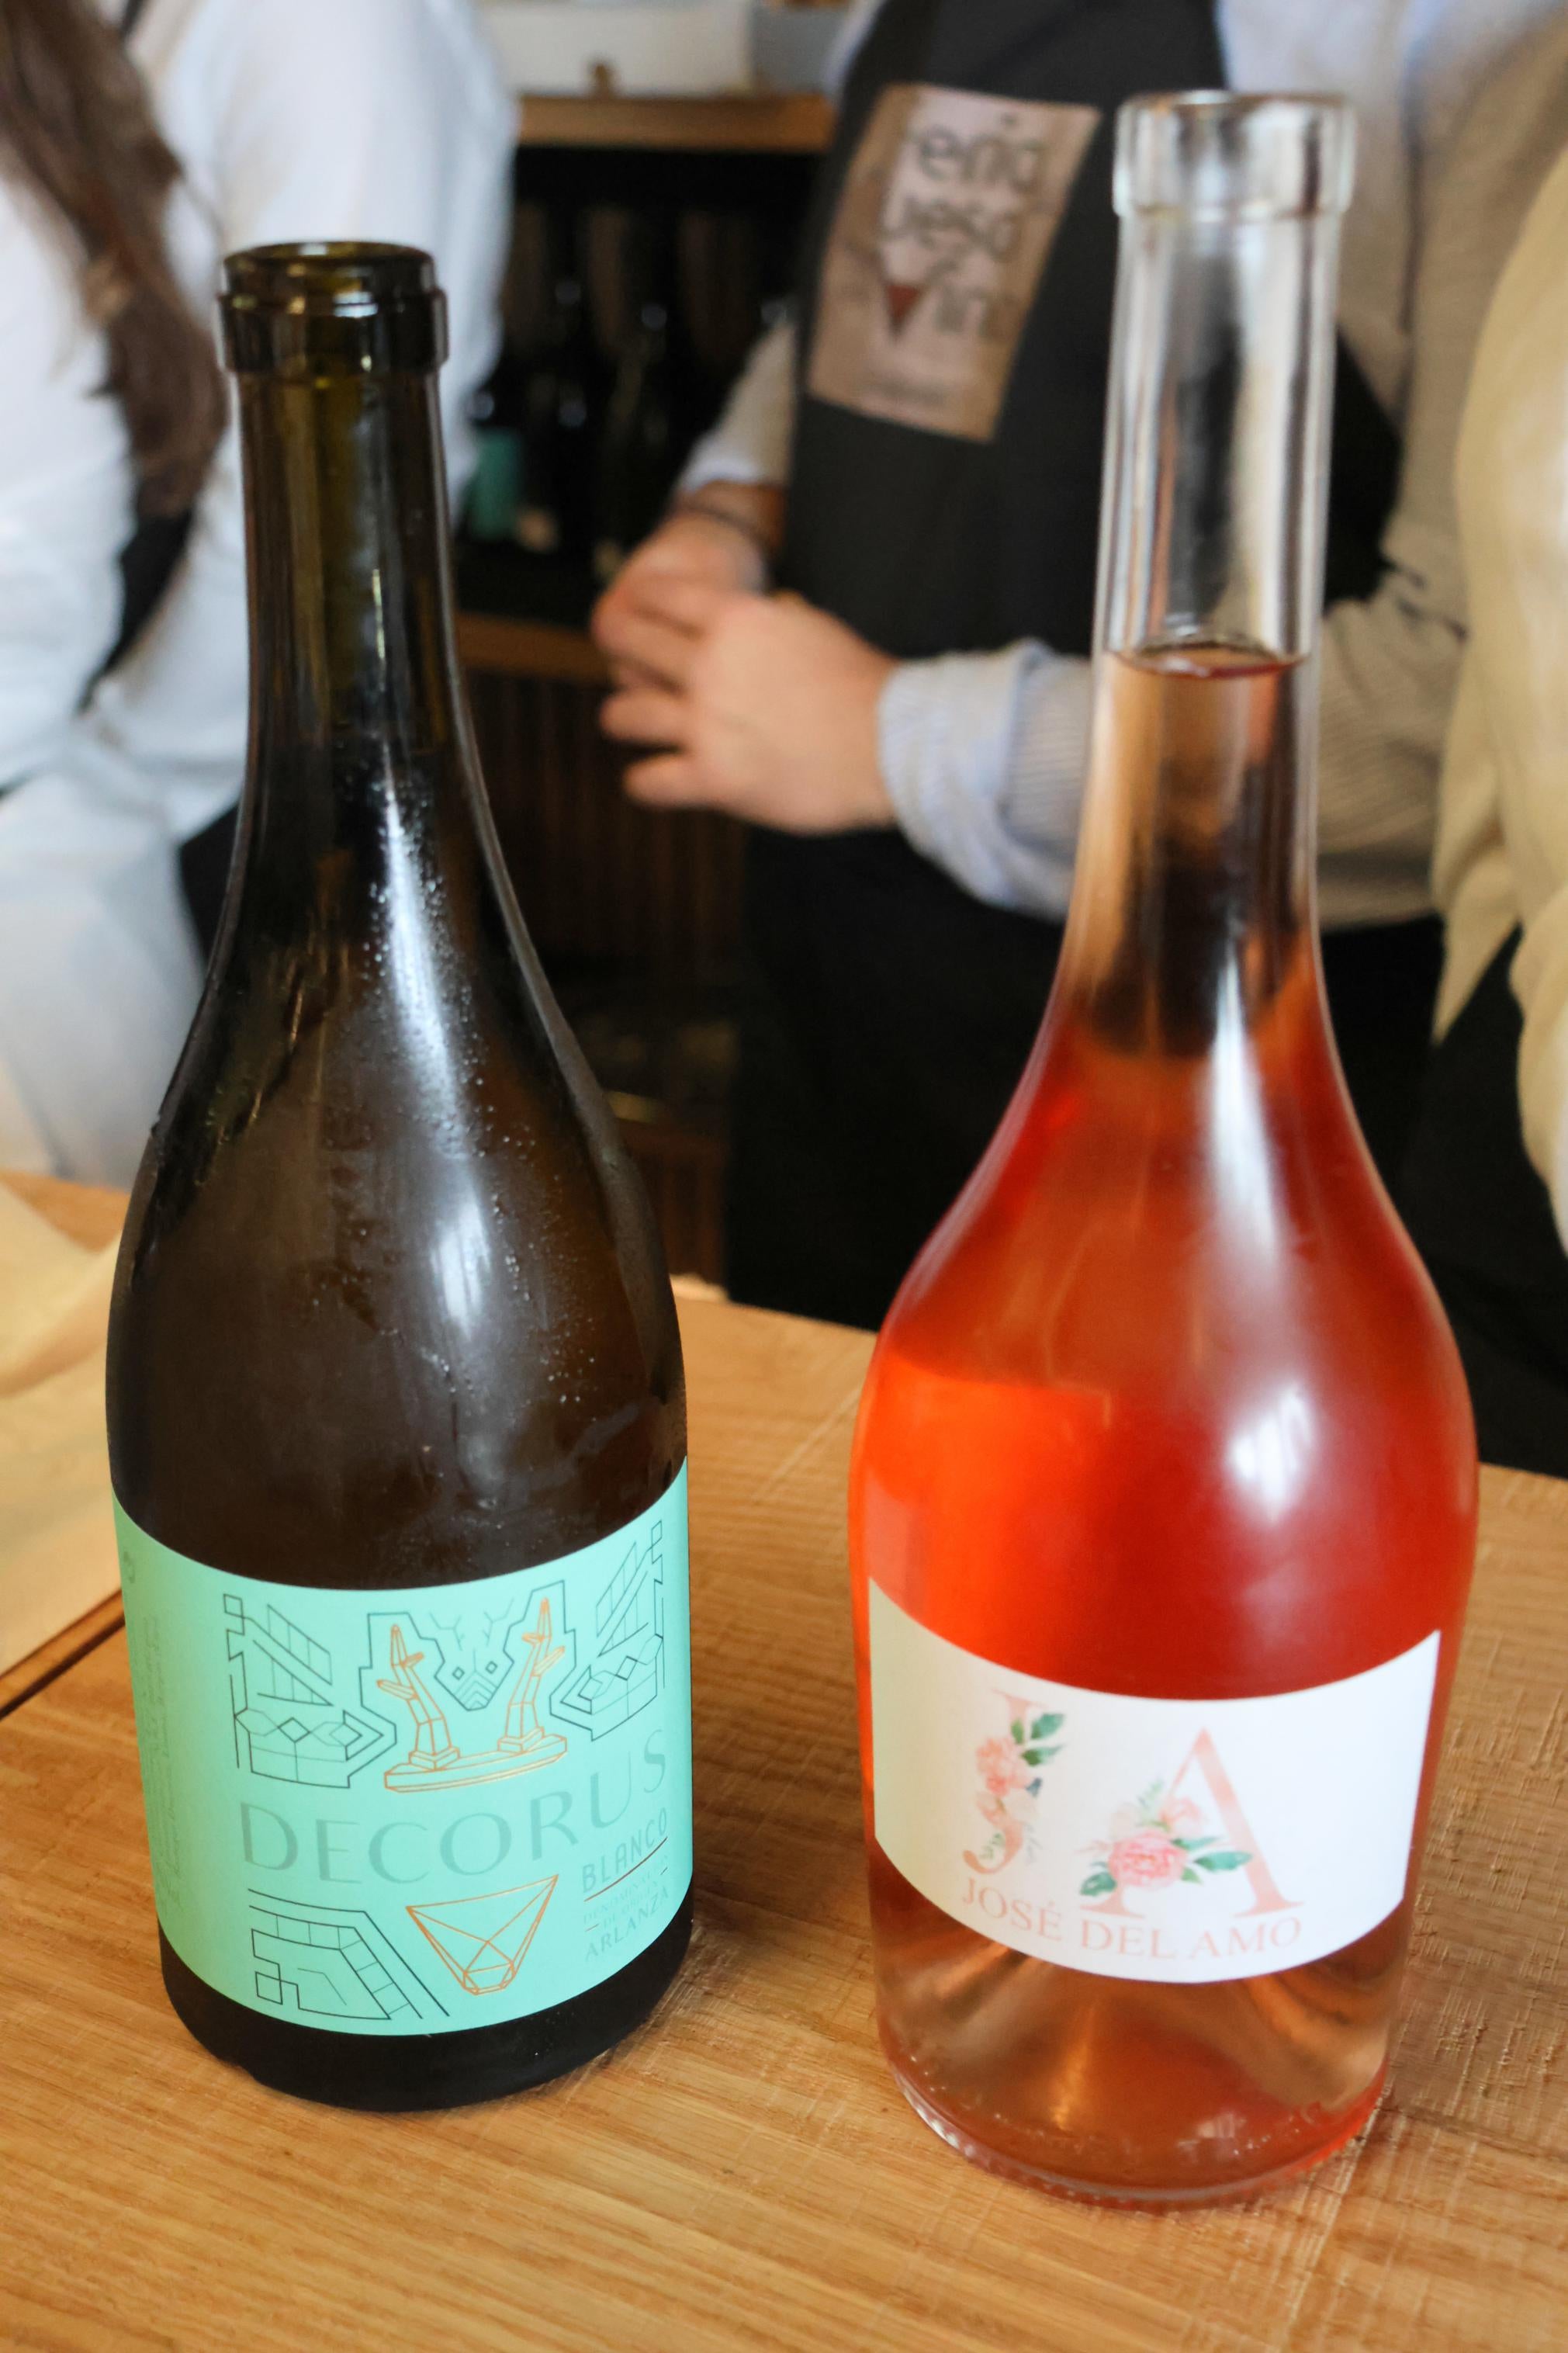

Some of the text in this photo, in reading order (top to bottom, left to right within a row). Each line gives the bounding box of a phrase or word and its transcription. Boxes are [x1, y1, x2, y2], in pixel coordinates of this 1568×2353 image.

[239, 1728, 666, 1885] DECORUS
[582, 1807, 668, 1894] BLANCO
[584, 1885, 670, 1963] ARLANZA
[961, 1877, 1302, 1960] JOSÉ DEL AMO
